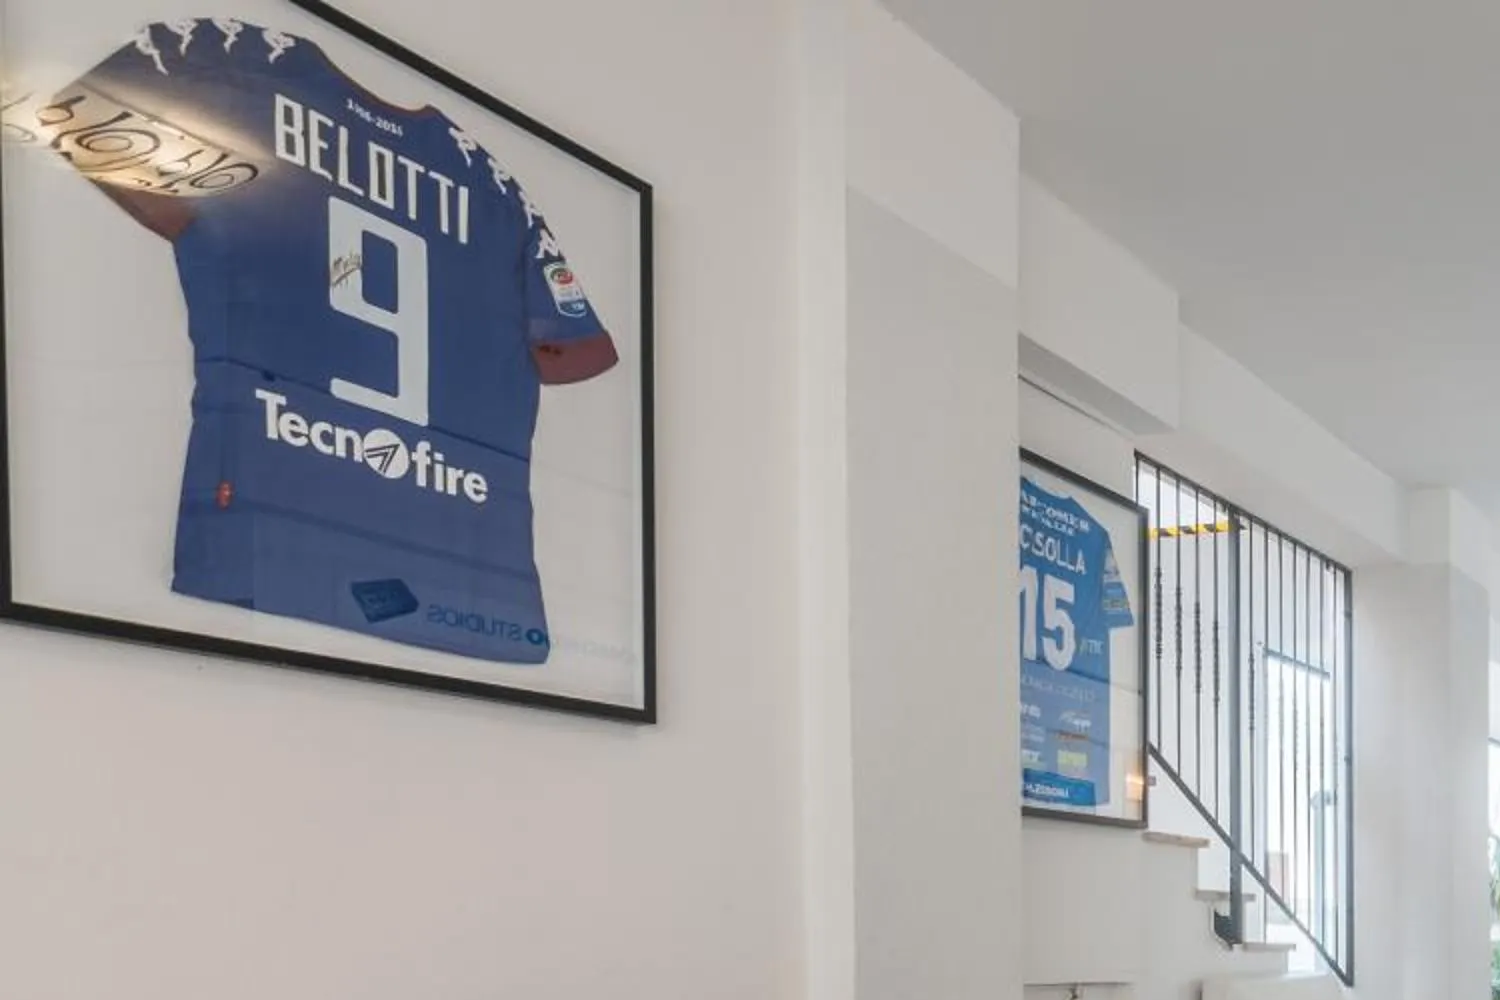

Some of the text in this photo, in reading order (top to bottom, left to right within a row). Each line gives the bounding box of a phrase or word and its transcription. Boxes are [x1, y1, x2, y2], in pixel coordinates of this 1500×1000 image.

[275, 93, 469, 244] BELOTTI
[328, 195, 429, 426] 9
[1019, 564, 1077, 672] 15
